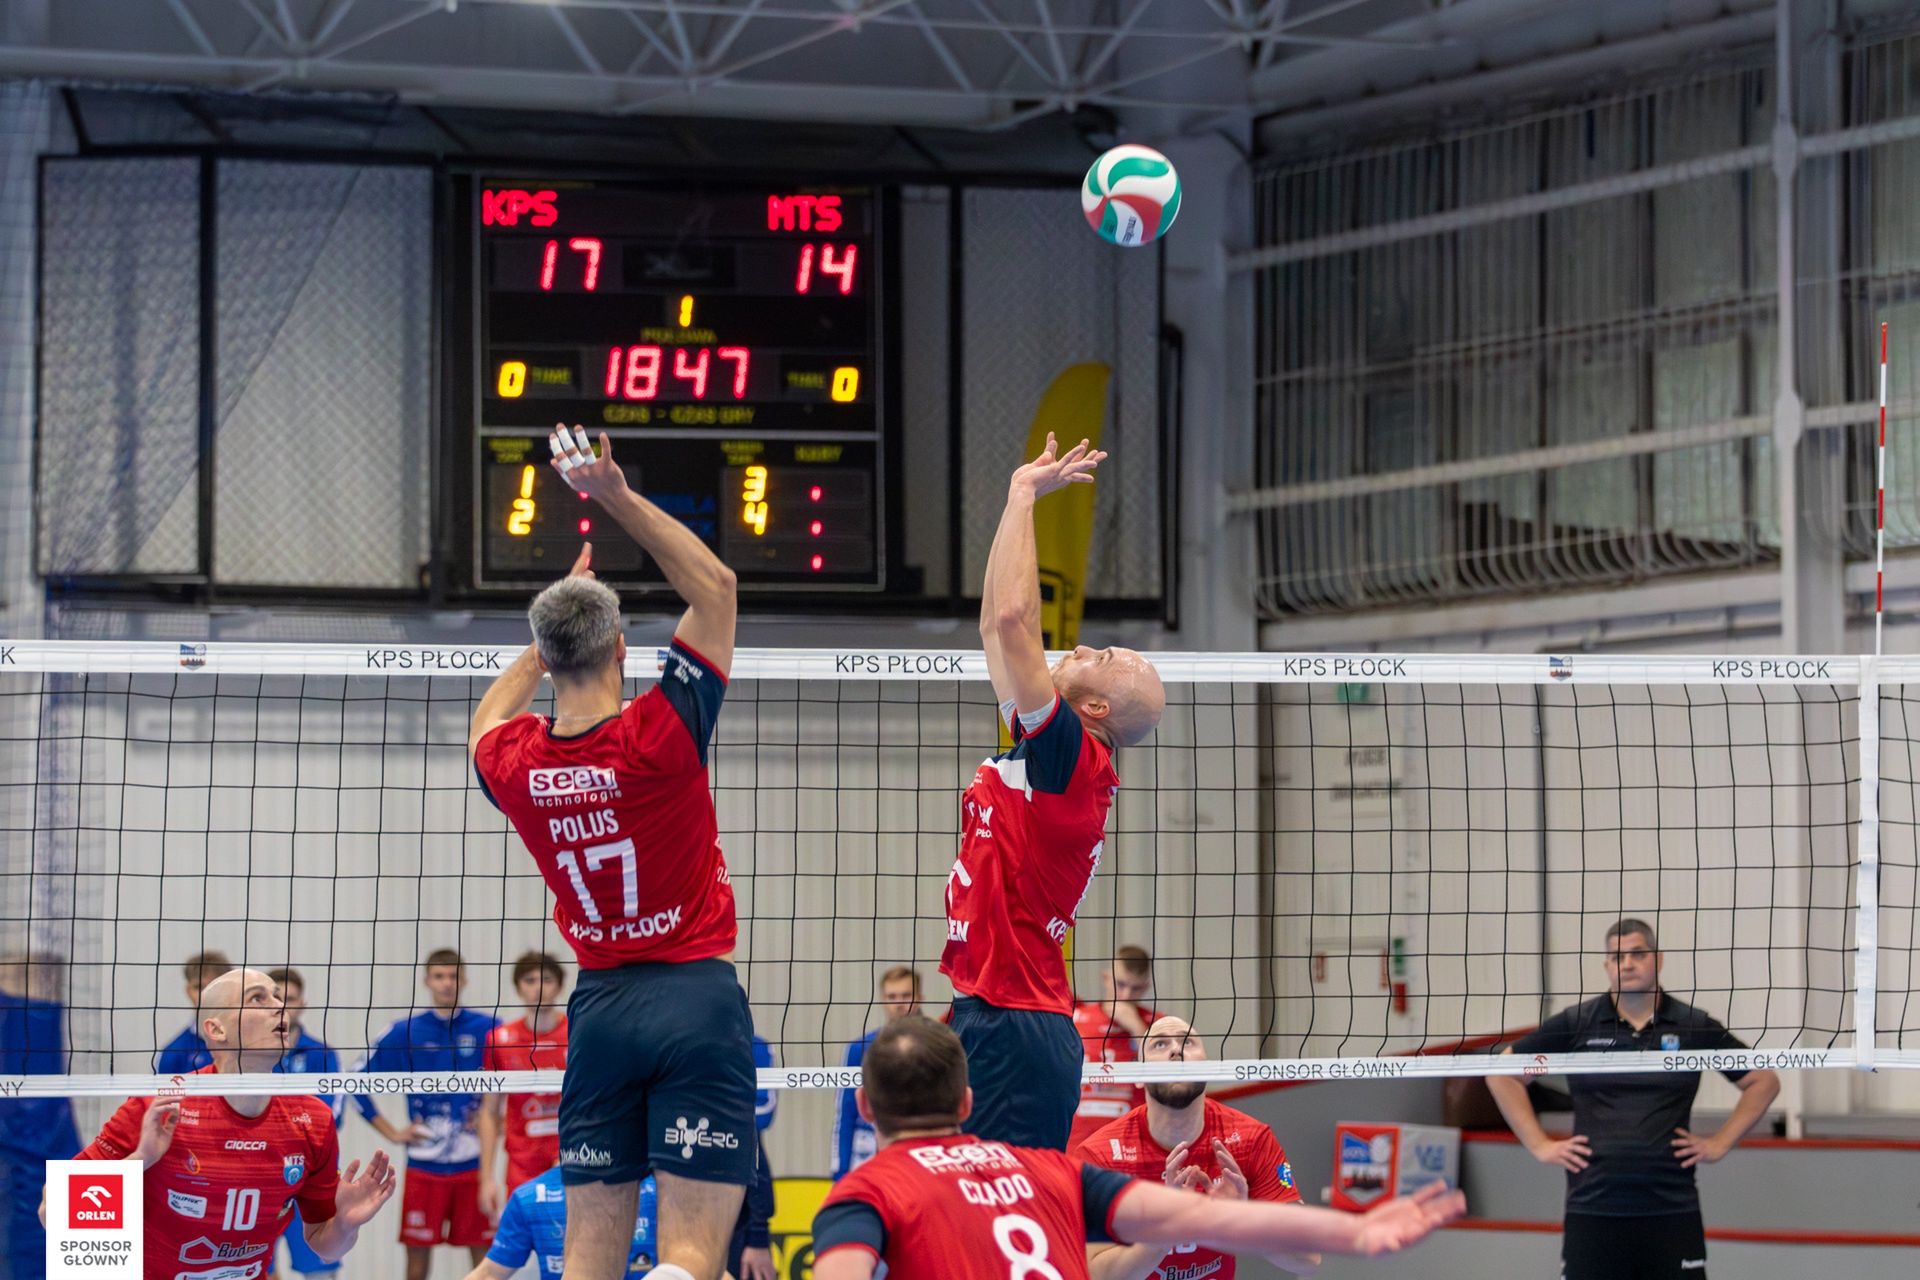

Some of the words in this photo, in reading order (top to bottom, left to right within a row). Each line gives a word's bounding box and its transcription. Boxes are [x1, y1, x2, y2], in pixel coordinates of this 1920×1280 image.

[482, 190, 558, 226] KPS
[768, 195, 842, 231] MTS
[540, 238, 602, 291] 17
[795, 243, 856, 295] 14
[679, 295, 693, 327] 1
[497, 361, 526, 398] 0
[831, 366, 859, 401] 0
[520, 465, 535, 498] 1
[743, 466, 767, 501] 3
[508, 498, 535, 535] 2
[743, 502, 768, 535] 4
[366, 649, 413, 669] KPS
[421, 650, 501, 670] PŁOCK
[835, 654, 880, 673] KPS
[887, 655, 964, 674] PŁOCK
[1284, 658, 1327, 676] KPS
[1333, 658, 1407, 677] PŁOCK
[1712, 660, 1754, 678] KPS
[1760, 660, 1830, 679] PŁOCK
[530, 766, 618, 795] seen
[532, 788, 623, 808] technologie
[548, 808, 620, 844] POLUS
[555, 836, 639, 924] 17
[611, 905, 682, 942] PŁOCK
[1235, 1063, 1323, 1081] SPONSOR
[1329, 1060, 1407, 1078] GŁÓWNY
[1663, 1054, 1749, 1071] SPONSOR
[1753, 1051, 1828, 1069] GŁÓWNY
[318, 1078, 415, 1094] SPONSOR
[420, 1074, 506, 1093] GŁÓWNY
[786, 1072, 864, 1088] SPONSO
[224, 1140, 267, 1151] GIOCCA
[283, 1154, 305, 1167] MTS
[222, 1188, 260, 1231] 10
[993, 1213, 1064, 1280] 8
